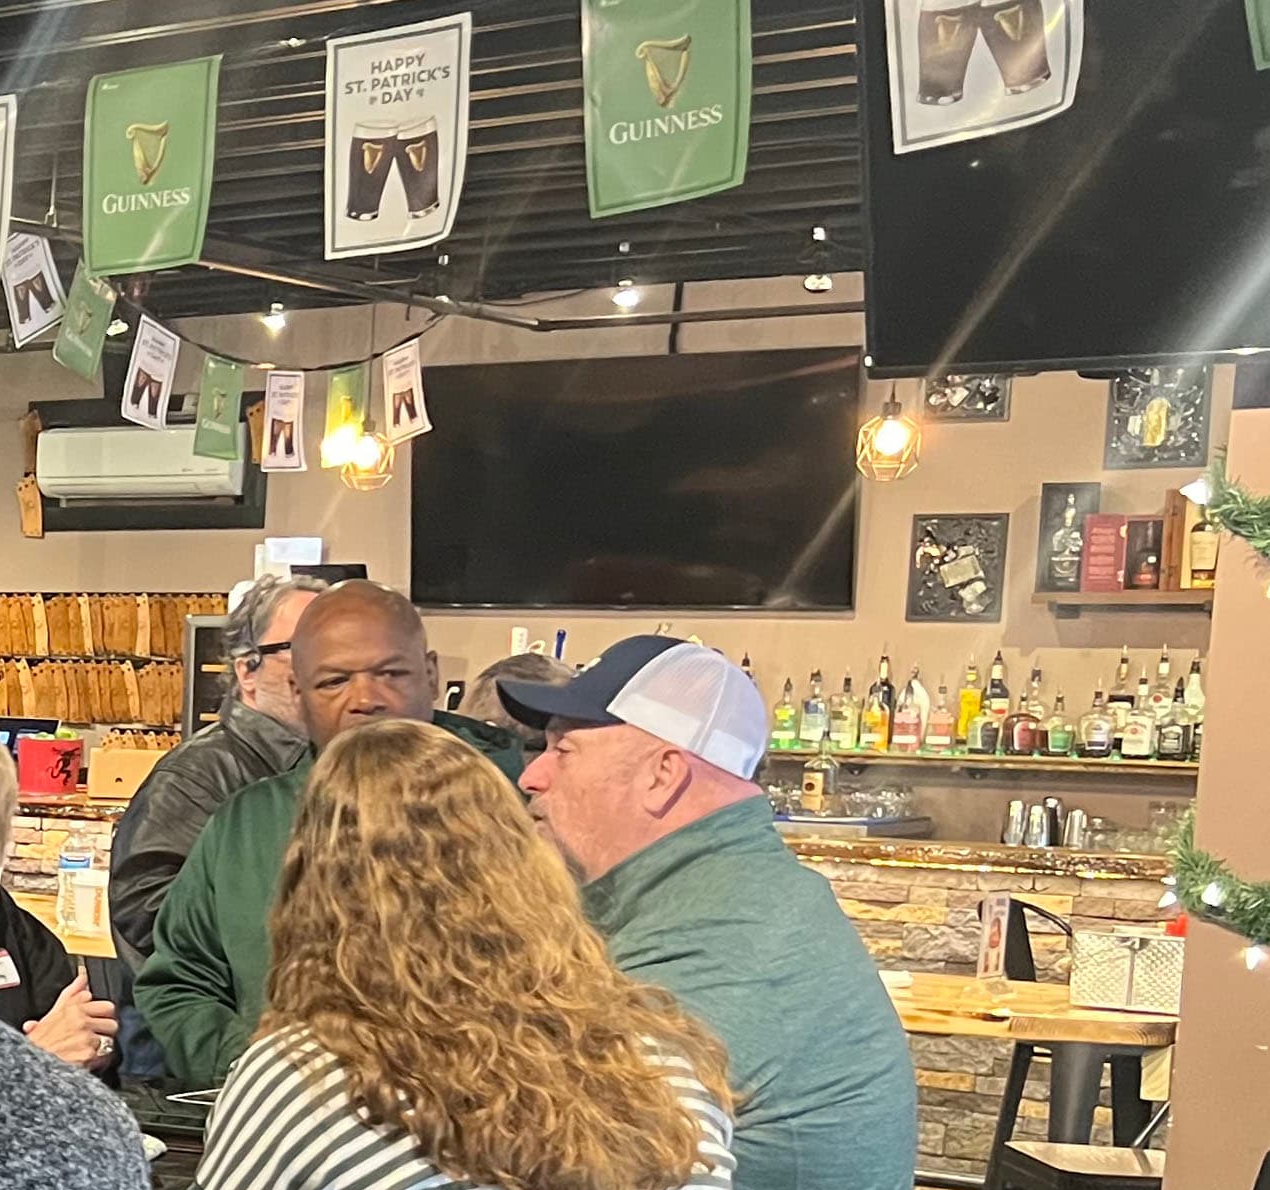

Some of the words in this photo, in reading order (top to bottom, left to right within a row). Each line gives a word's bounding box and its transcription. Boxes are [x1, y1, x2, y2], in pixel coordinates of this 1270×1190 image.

[371, 53, 426, 75] HAPPY
[344, 79, 367, 95] ST.
[371, 65, 451, 92] PATRICK'S
[381, 88, 412, 105] DAY
[608, 104, 723, 145] GUINNESS
[102, 187, 191, 214] GUINNESS
